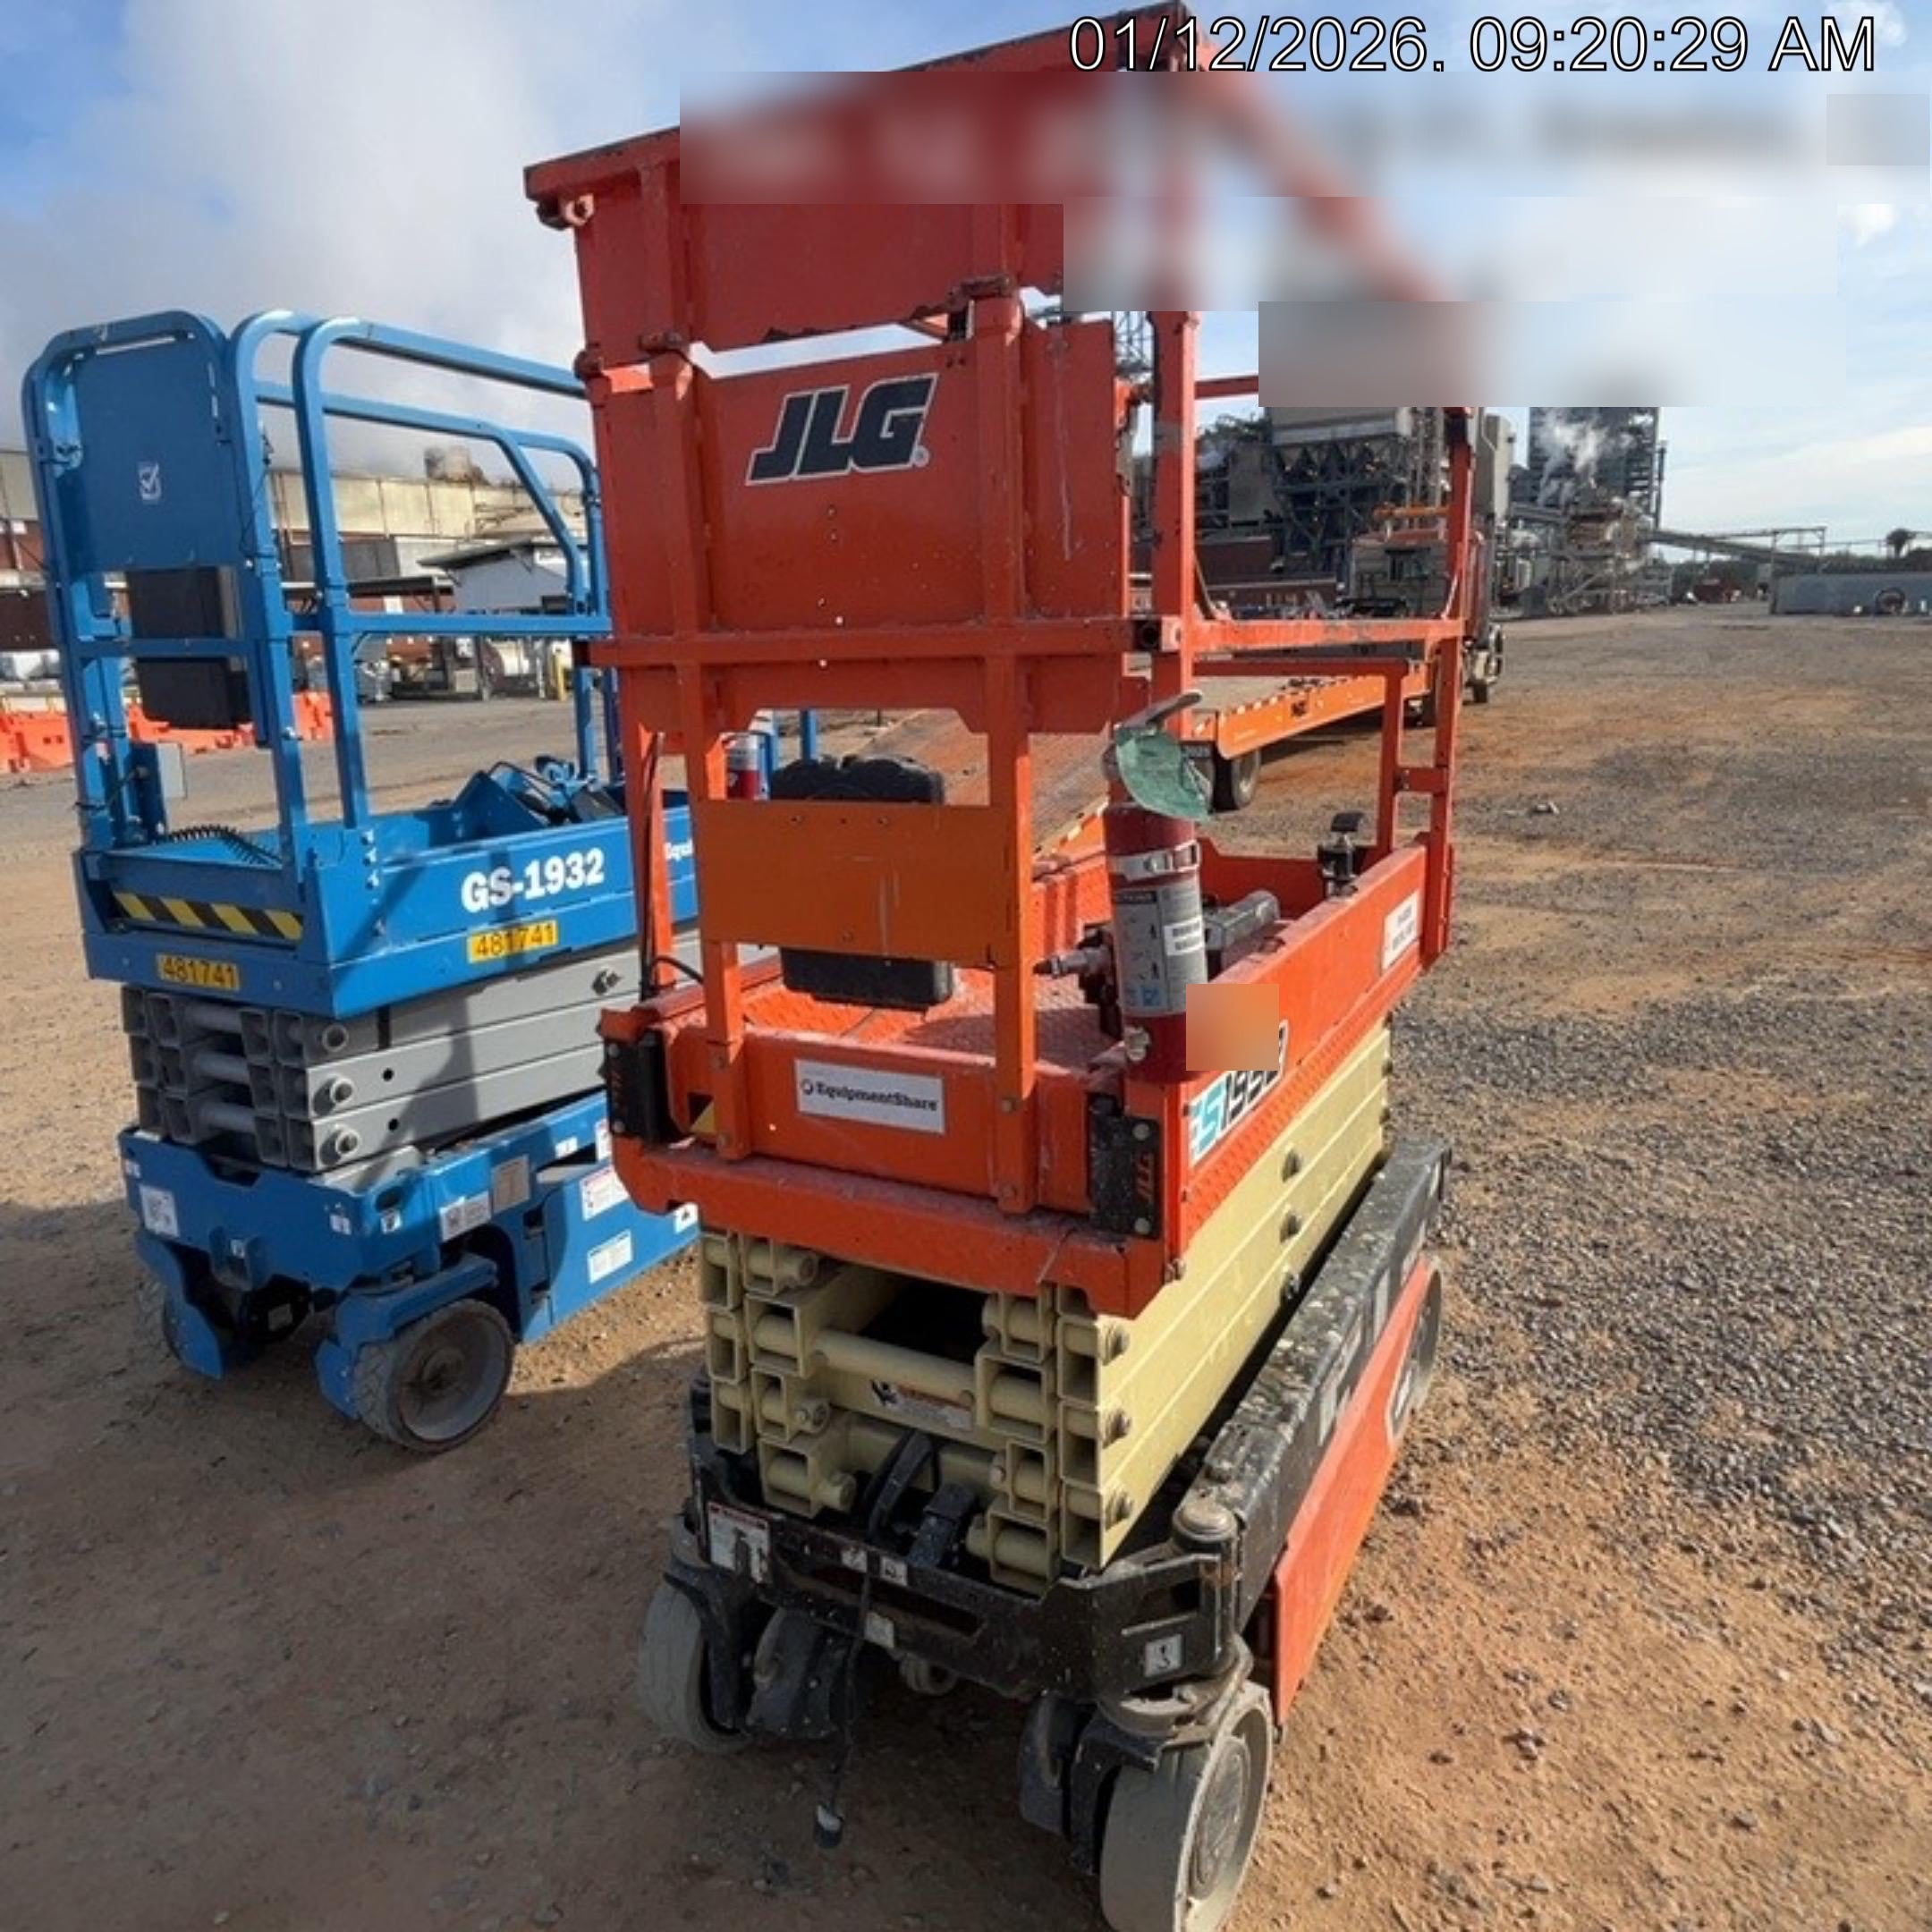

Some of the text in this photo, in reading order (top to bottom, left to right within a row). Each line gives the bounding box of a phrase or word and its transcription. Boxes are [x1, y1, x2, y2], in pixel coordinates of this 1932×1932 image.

[745, 372, 939, 487] JLG
[461, 847, 606, 913] GS-1932
[476, 922, 553, 956] 481741
[815, 1080, 937, 1111] EquipmentShare
